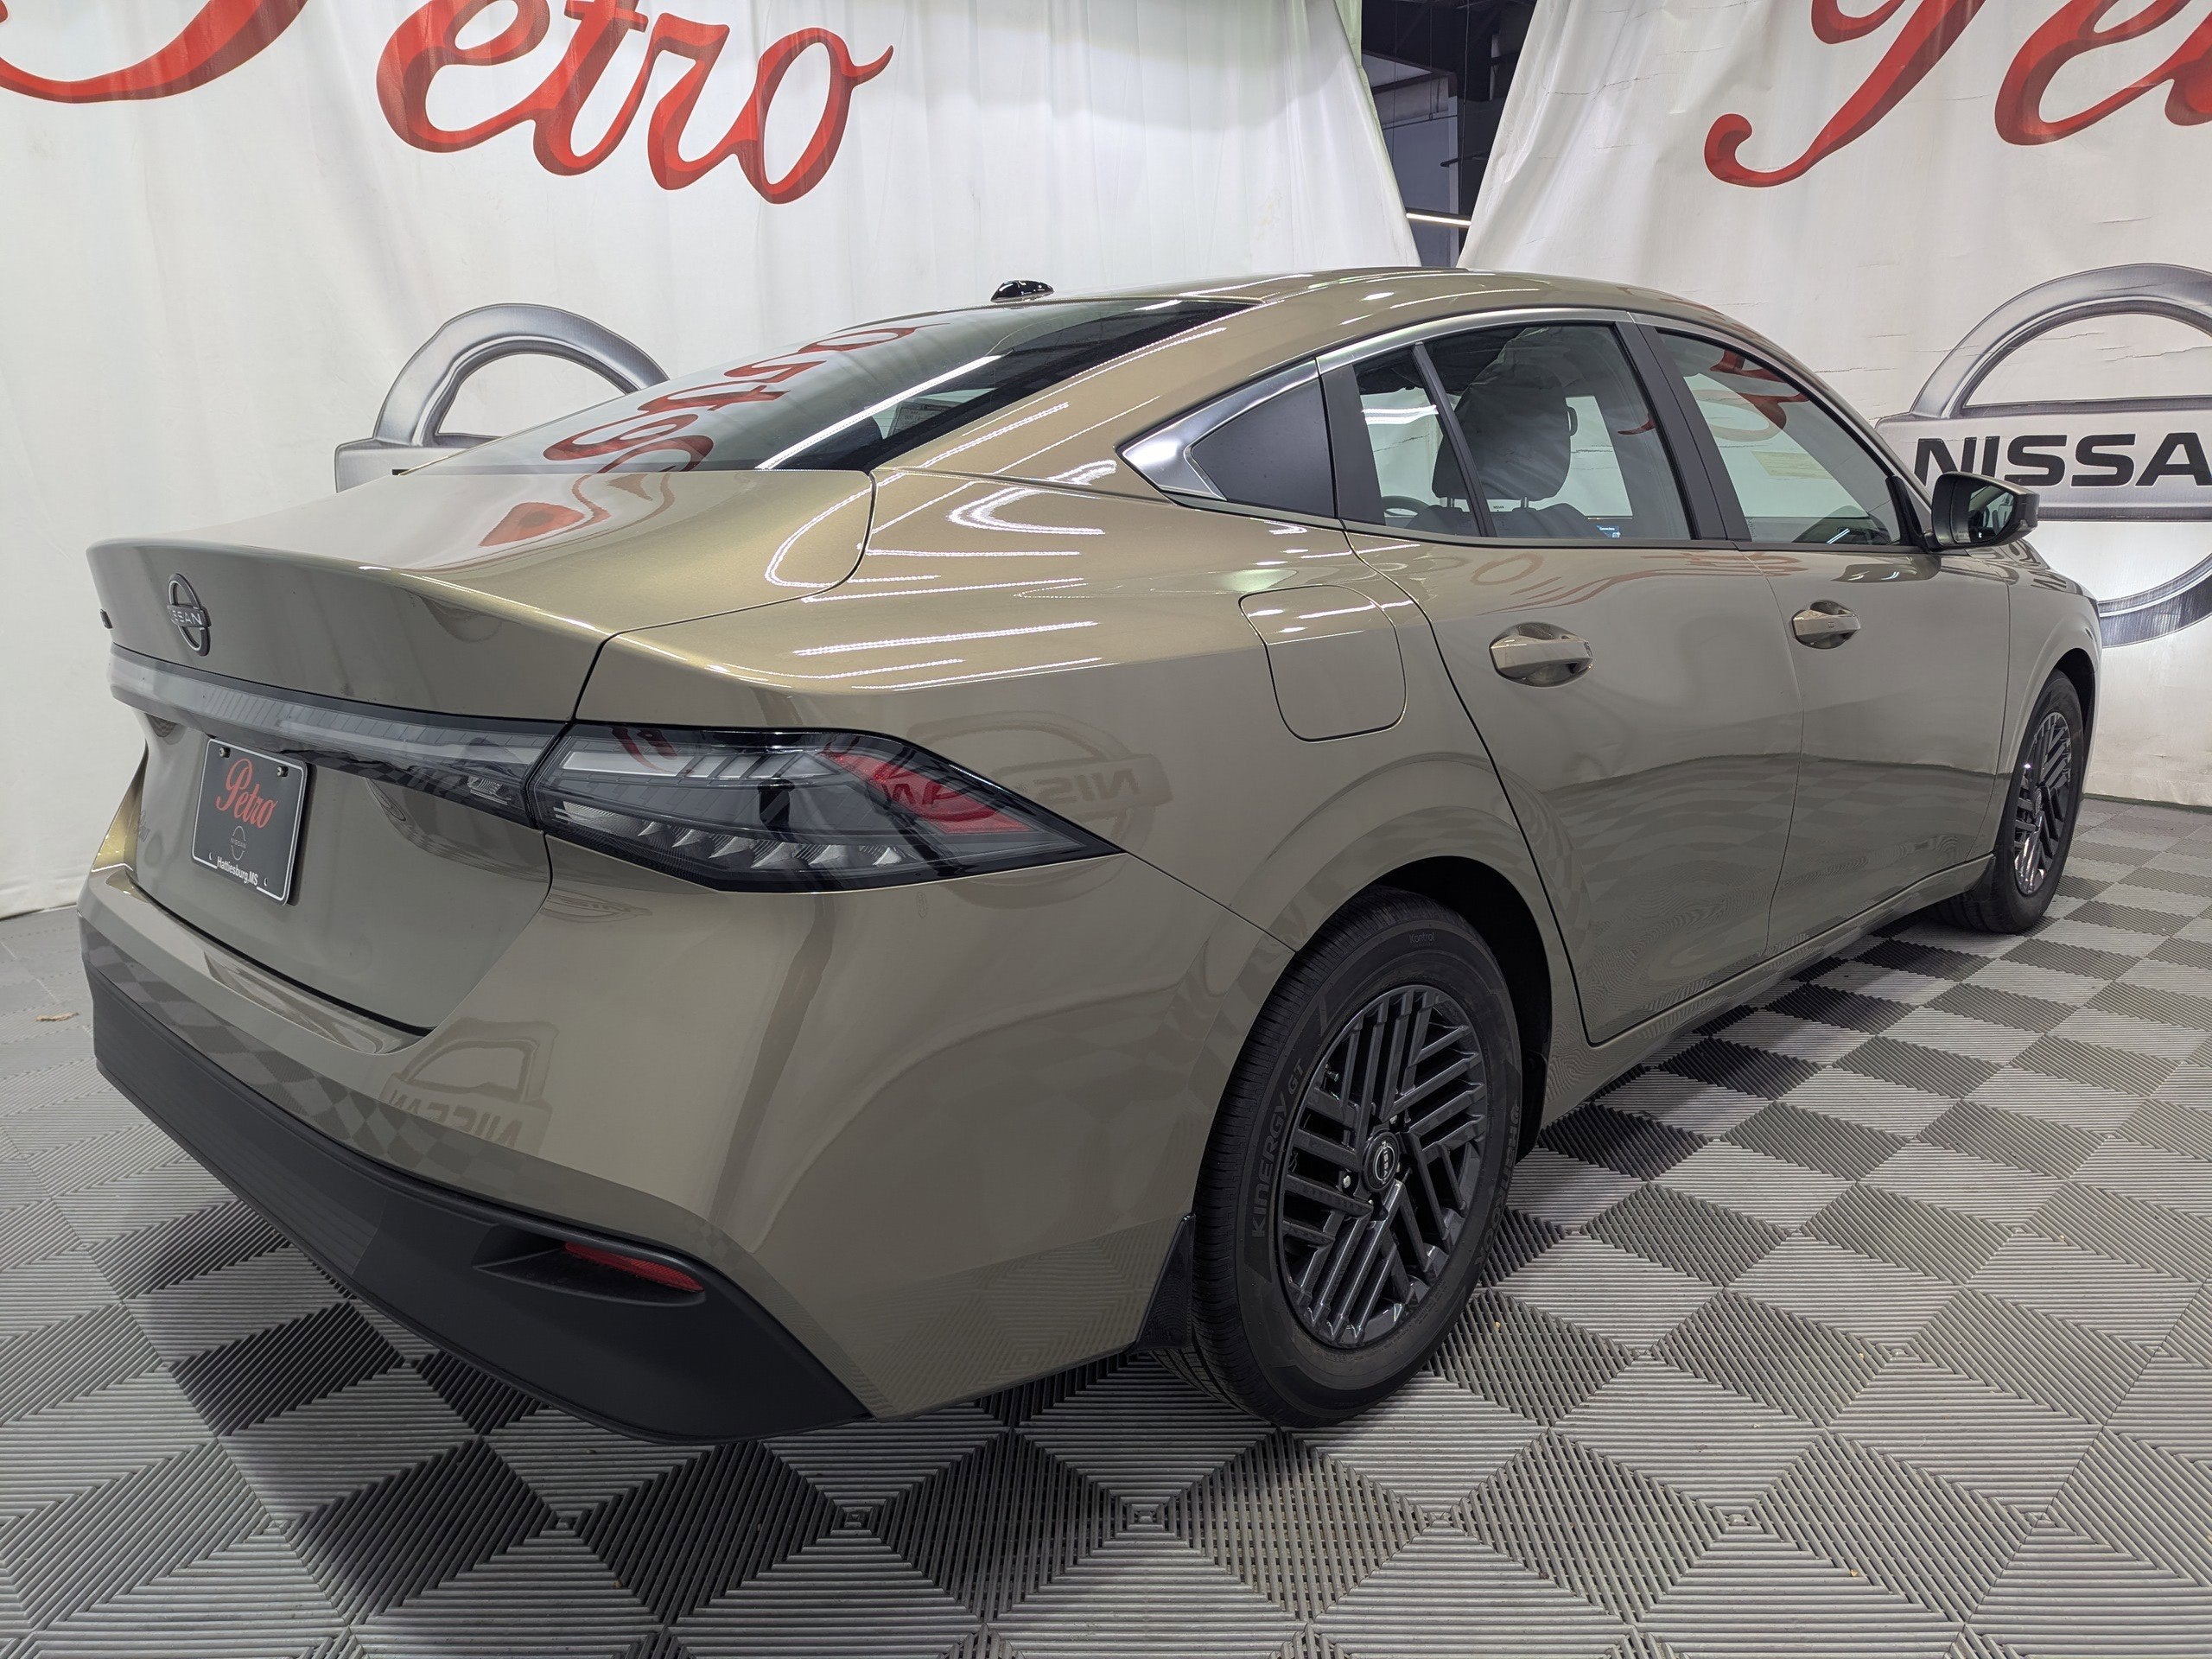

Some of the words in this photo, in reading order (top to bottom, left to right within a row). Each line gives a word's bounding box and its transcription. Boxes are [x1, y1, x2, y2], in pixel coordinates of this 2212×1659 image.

[0, 0, 894, 204] etro
[215, 758, 278, 829] Petro
[1287, 1058, 1304, 1095] GT
